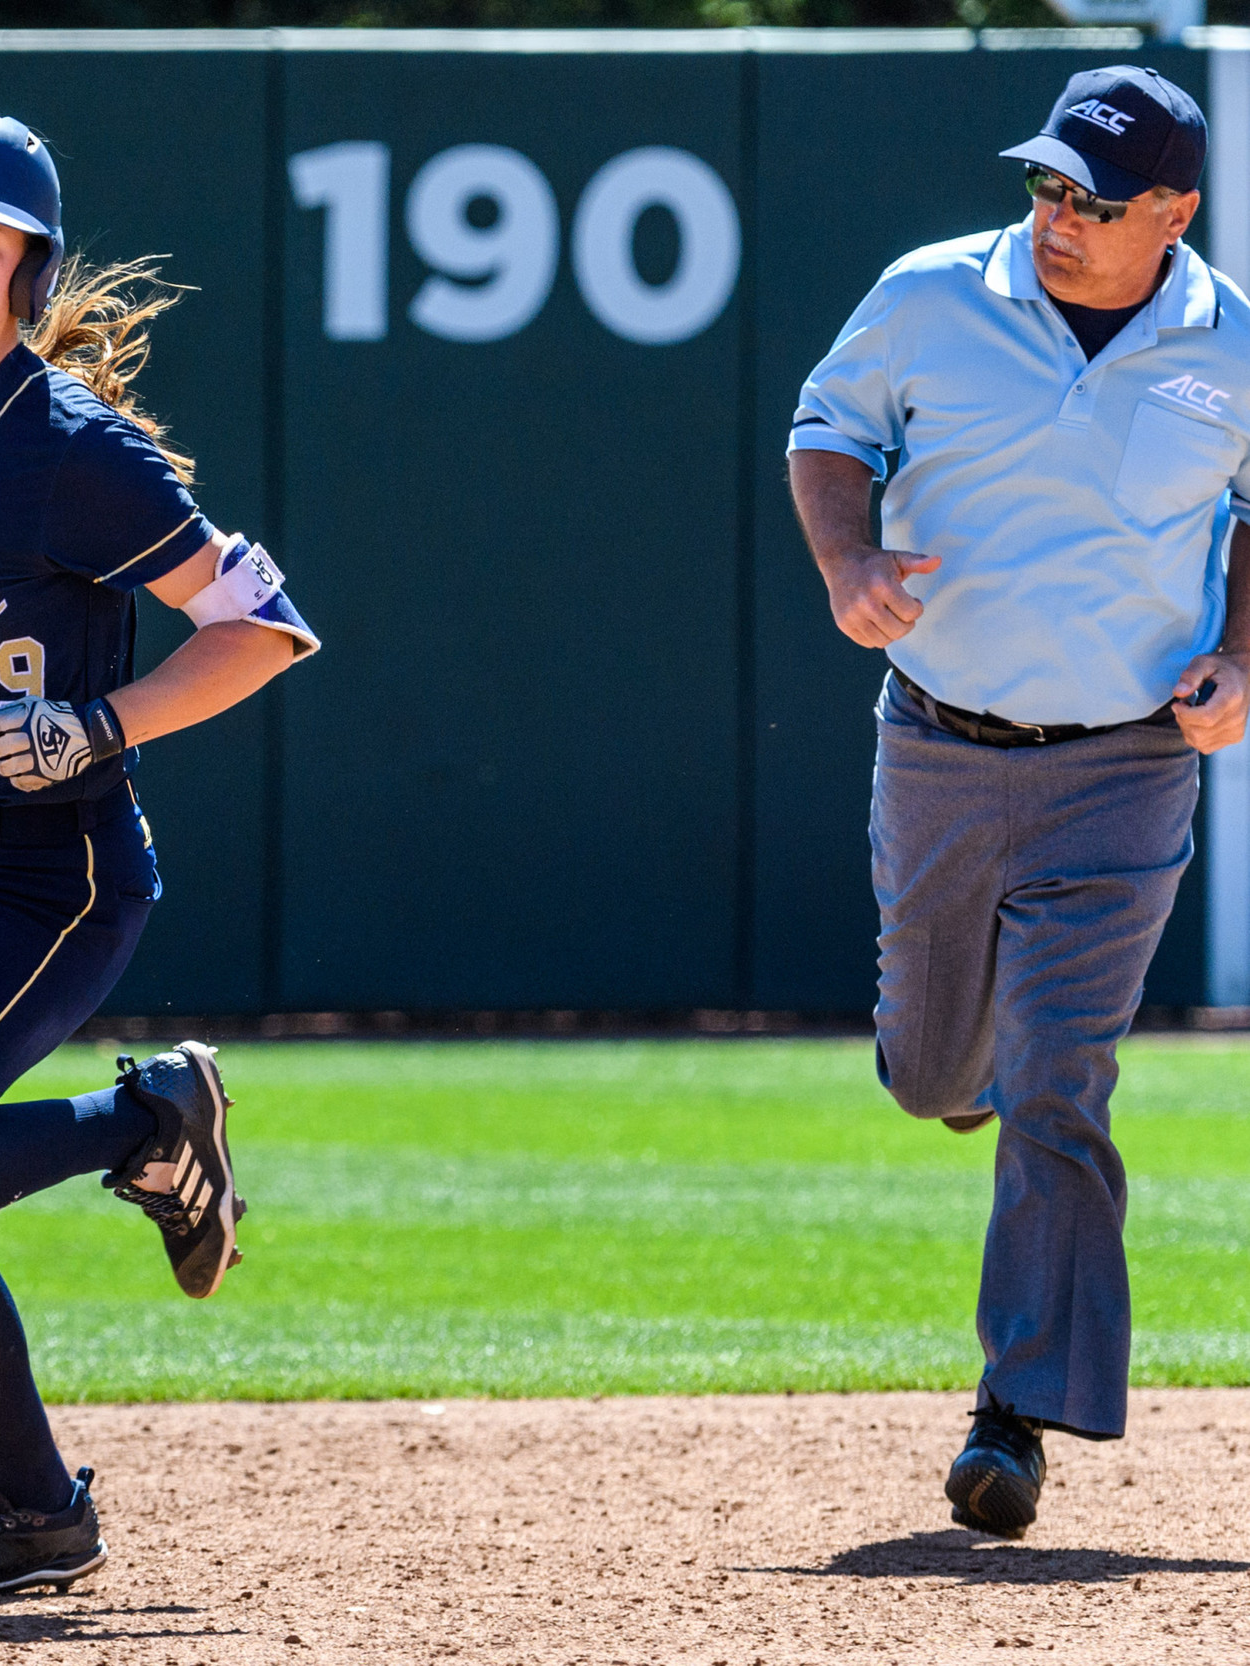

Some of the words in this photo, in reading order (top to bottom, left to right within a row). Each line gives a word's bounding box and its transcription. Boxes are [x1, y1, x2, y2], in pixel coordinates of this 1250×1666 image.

[1067, 99, 1136, 135] ACC
[287, 140, 743, 346] 190
[1156, 374, 1231, 413] ACC
[96, 708, 114, 740] LOUISVILLE
